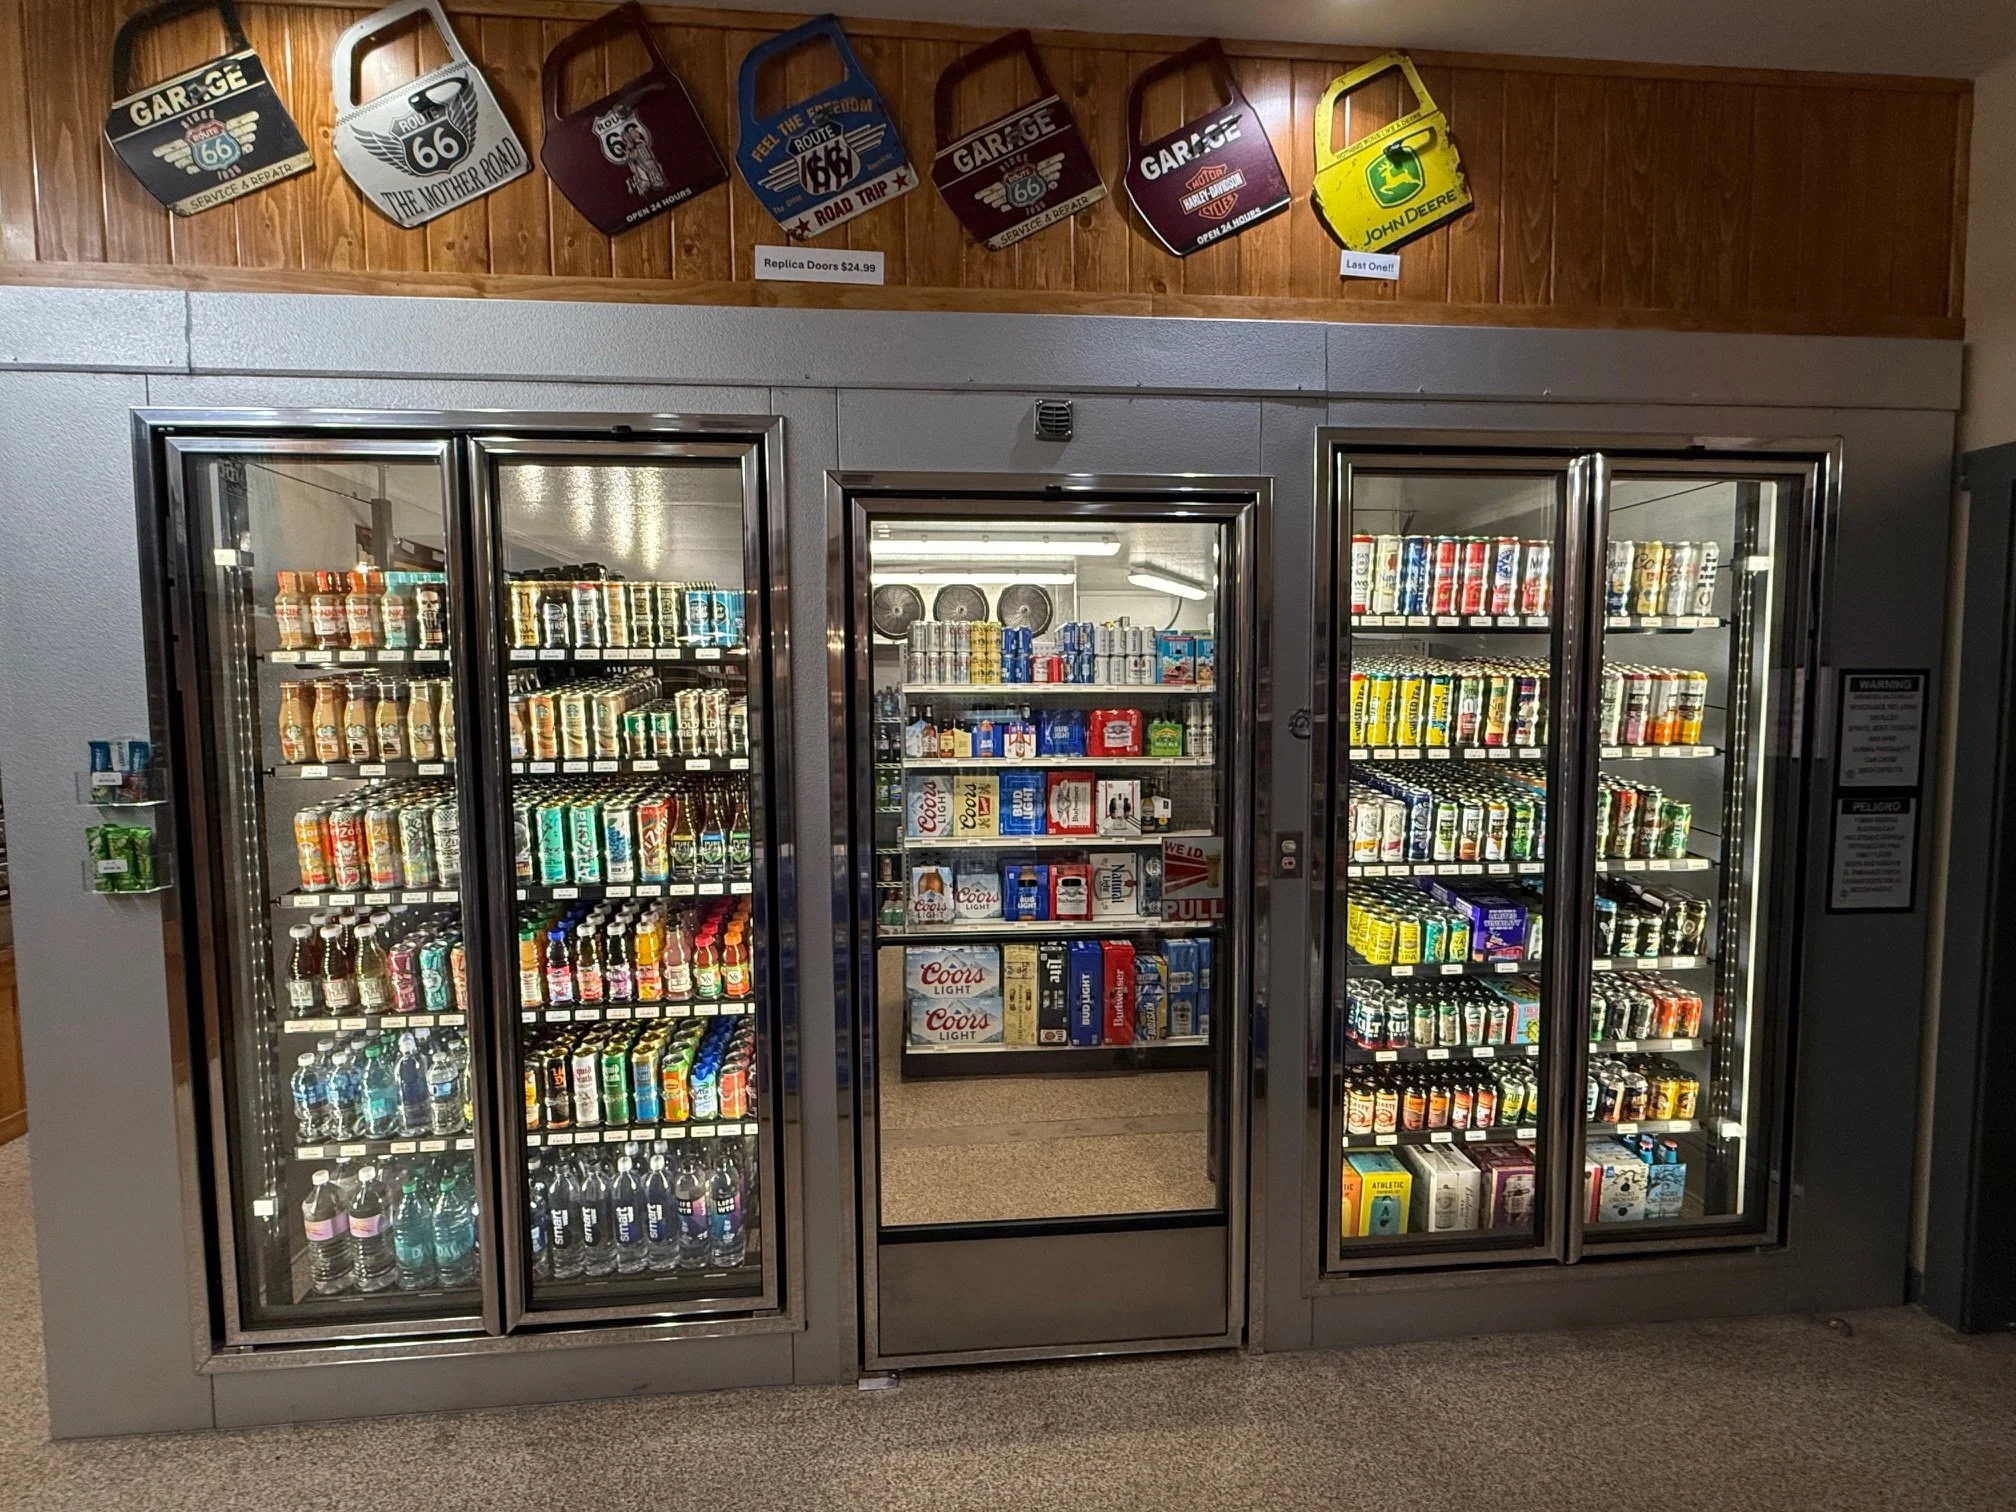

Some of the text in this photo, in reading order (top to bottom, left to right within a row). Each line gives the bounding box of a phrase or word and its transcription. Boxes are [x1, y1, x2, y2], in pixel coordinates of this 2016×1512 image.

[200, 138, 231, 165] 66
[412, 126, 459, 169] 66
[752, 134, 781, 163] FEEL
[777, 113, 804, 137] THE
[794, 125, 836, 151] ROUTE
[380, 136, 522, 222] THE MOTHER ROAD
[806, 140, 849, 189] 66
[1192, 169, 1223, 188] MOTOR
[190, 162, 294, 210] SERVICE & REPAIR
[1014, 178, 1040, 202] 66
[1182, 172, 1243, 212] HARLEY-DAVIDSON
[626, 187, 693, 222] OPEN 24 HOURS
[814, 180, 889, 227] ROAD TRIP
[1203, 194, 1234, 217] CYCLES
[1364, 189, 1457, 247] JOHN DEERE
[1000, 196, 1089, 245] SERVICE & REPAIR
[1197, 207, 1262, 246] OPEN 24 HOURS
[763, 258, 876, 273] Replica Doors $24.99
[1346, 259, 1395, 273] Last One!!
[1859, 679, 1912, 690] WARNING
[681, 721, 699, 729] OLD
[1409, 701, 1418, 737] TWISTED
[917, 780, 937, 834] Coors
[937, 789, 946, 824] LIGHT
[959, 782, 977, 830] Coors
[1012, 790, 1023, 817] BUD
[1023, 787, 1034, 820] LIGHT
[1852, 801, 1901, 812] PELIGRO
[1164, 840, 1185, 855] WE
[957, 887, 1000, 903] Coors
[1019, 895, 1036, 903] BUD
[1111, 864, 1126, 904] Natural
[914, 898, 948, 912] Coors
[1163, 900, 1224, 921] PULL
[920, 961, 985, 985] Coors
[934, 985, 971, 995] LIGHT
[1081, 973, 1091, 1025] BUD LIGHT
[1113, 968, 1125, 1028] Budweiser
[926, 1008, 990, 1031] Coors
[940, 1031, 977, 1041] LIGHT
[1350, 1102, 1370, 1112] OASTY
[1372, 1181, 1405, 1189] ATHLETIC
[551, 1209, 564, 1245] smart
[581, 1206, 593, 1243] smart
[616, 1206, 630, 1242] smart
[647, 1203, 658, 1239] smart
